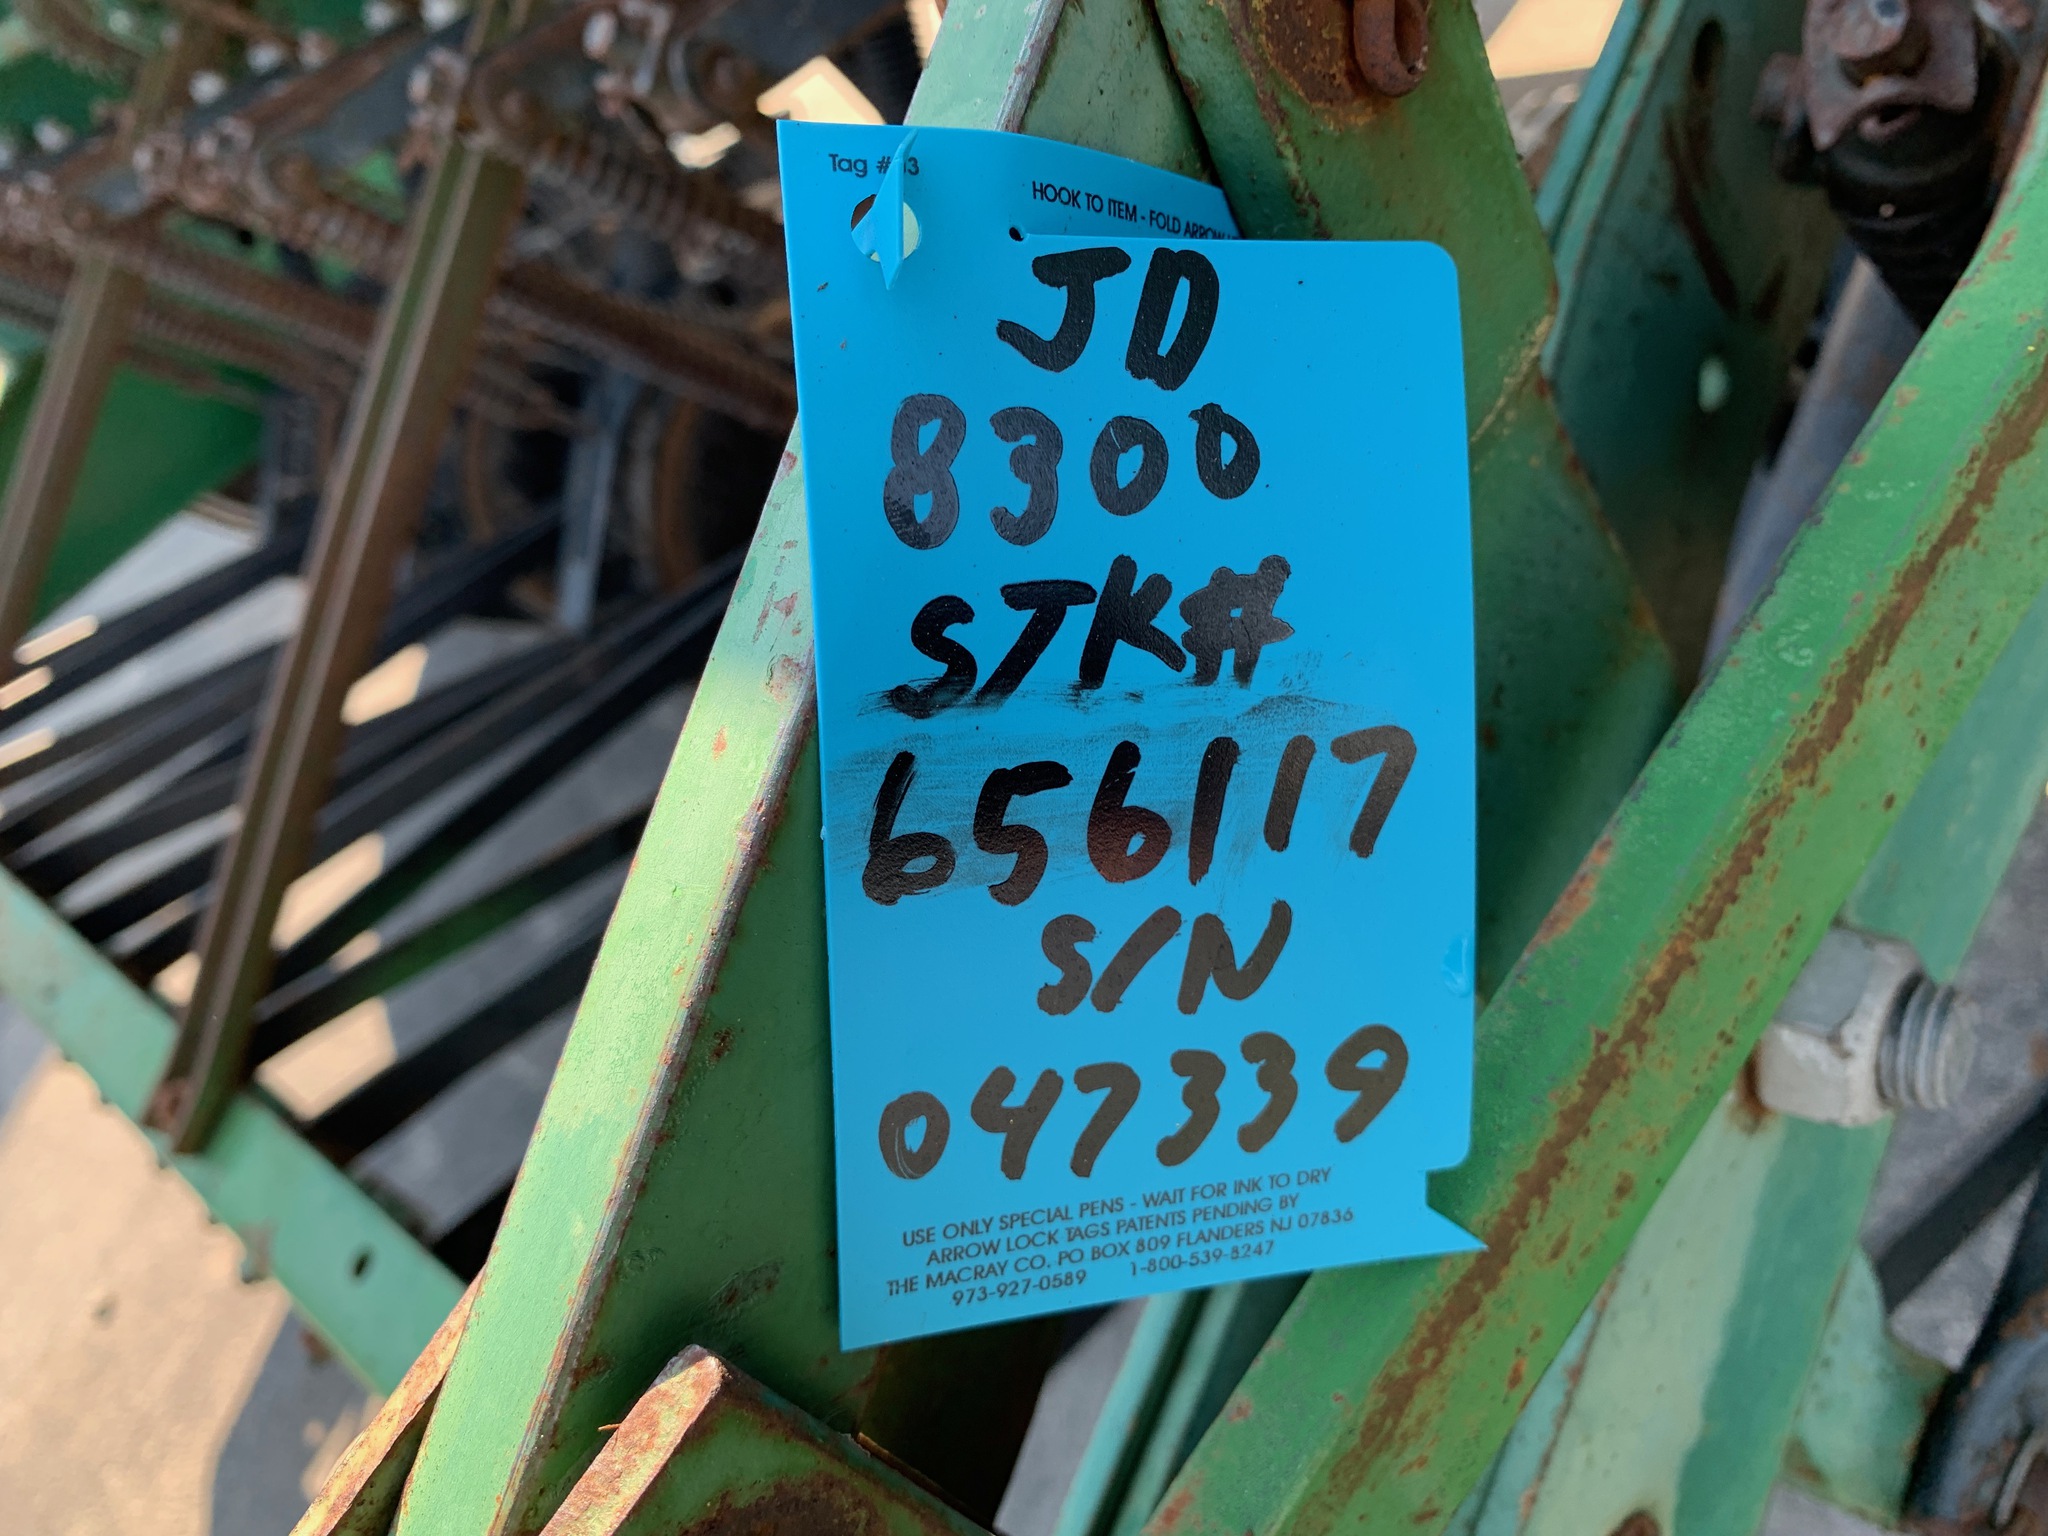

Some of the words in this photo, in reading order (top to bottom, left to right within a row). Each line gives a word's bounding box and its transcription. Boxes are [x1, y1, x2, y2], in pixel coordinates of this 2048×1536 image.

[828, 153, 868, 178] Tag
[1032, 180, 1081, 209] HOOK
[1084, 192, 1104, 213] TO
[1108, 198, 1138, 223] ITEM
[1149, 209, 1181, 234] FOLD
[996, 246, 1220, 391] JD
[883, 393, 1260, 550] 8300
[888, 554, 1295, 719] STK#
[861, 725, 1417, 906] 656117
[1037, 899, 1293, 1015] S/N
[879, 1023, 1409, 1180] 047339
[887, 1275, 918, 1296] THE
[926, 1260, 1009, 1289] MACRAY
[1014, 1254, 1051, 1273] CO.
[1058, 1248, 1084, 1266] PO
[1091, 1241, 1130, 1261] BOX
[1136, 1235, 1171, 1253] 809
[1177, 1220, 1264, 1248] FLANDERS
[1270, 1216, 1293, 1233] NJ
[1298, 1207, 1354, 1229] 07836
[903, 1226, 936, 1247] USE
[943, 1216, 994, 1240] ONLY
[999, 1205, 1074, 1231] SPECIAL
[1079, 1197, 1124, 1218] PENS
[1142, 1187, 1186, 1208] WAIT
[1191, 1182, 1227, 1202] FOR
[1234, 1176, 1263, 1195] INK
[1268, 1173, 1290, 1189] TO
[1297, 1167, 1332, 1186] DRY
[926, 1238, 1001, 1266] ARROW
[1006, 1229, 1060, 1252] LOCK
[1066, 1221, 1110, 1242] TAGS
[1116, 1210, 1186, 1235] PATENTS
[1193, 1197, 1272, 1223] PENDING
[1279, 1193, 1300, 1210] BY
[952, 1269, 1087, 1306] 973-927-0589
[1131, 1240, 1275, 1276] 1-800-539-8247
